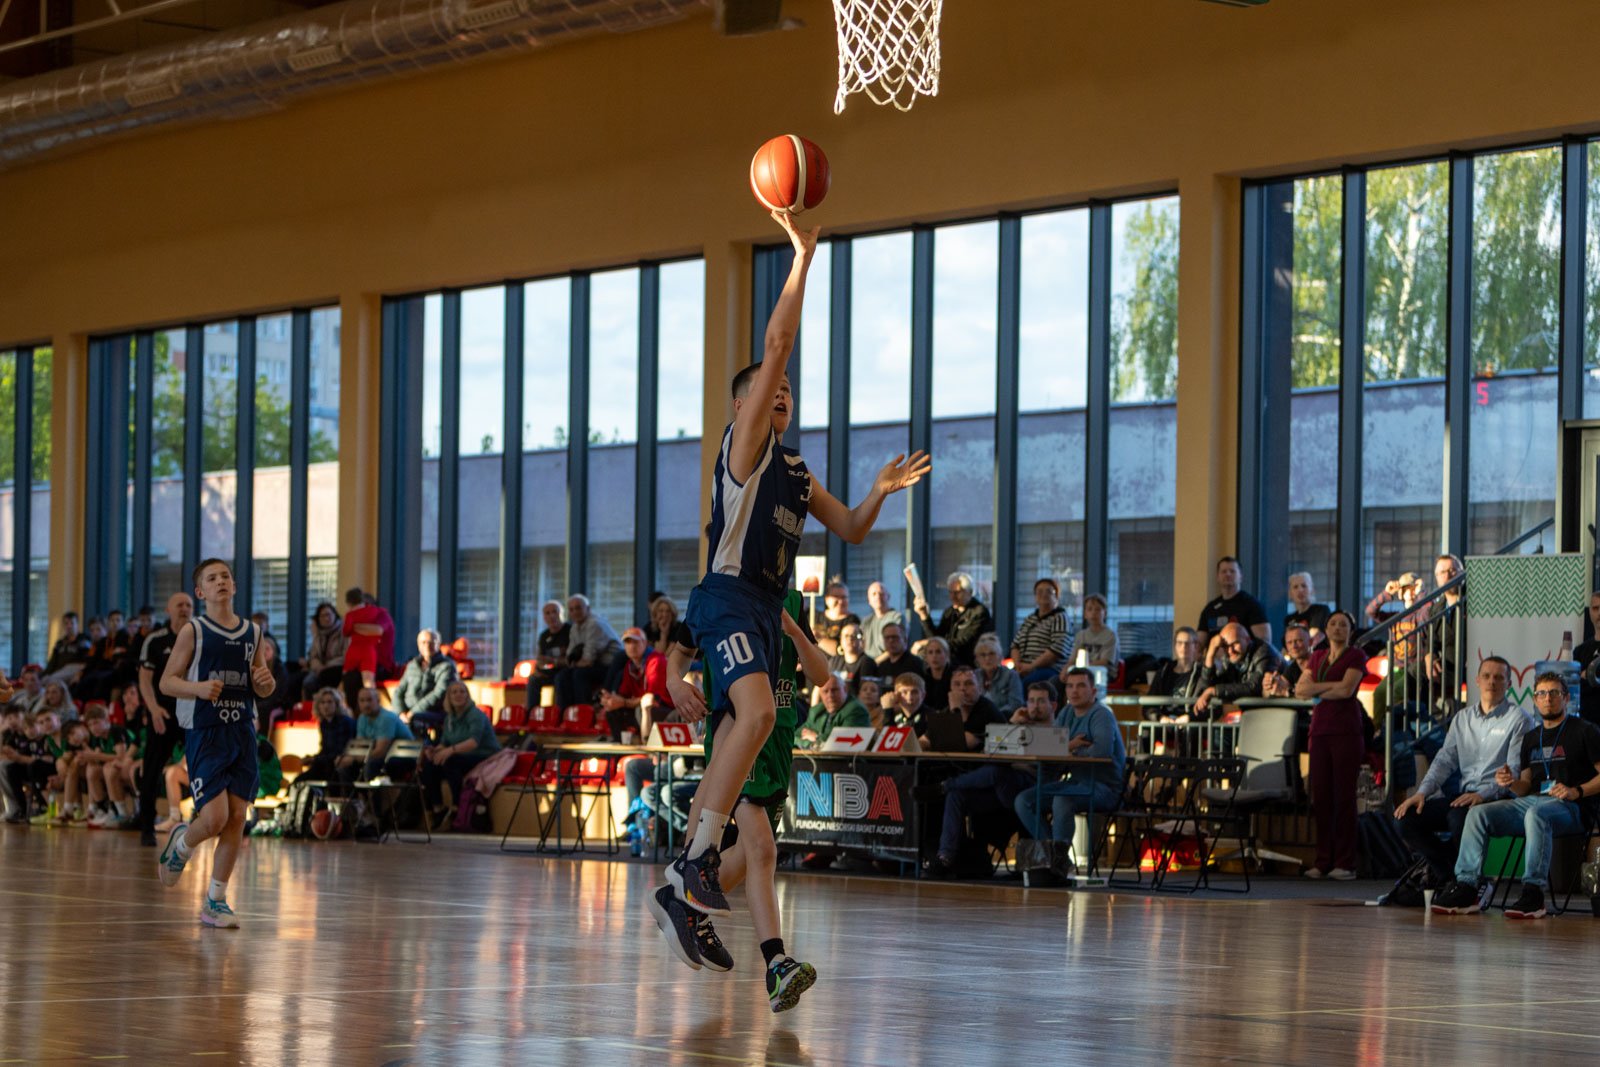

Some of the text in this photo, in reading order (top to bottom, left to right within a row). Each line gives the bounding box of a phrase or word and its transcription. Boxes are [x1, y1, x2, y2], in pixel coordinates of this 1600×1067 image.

[716, 631, 754, 675] 30
[663, 726, 687, 744] 5
[884, 731, 904, 749] 5
[796, 770, 904, 821] NBA
[795, 819, 825, 832] FUNDACJA
[876, 824, 904, 835] ACADEMY
